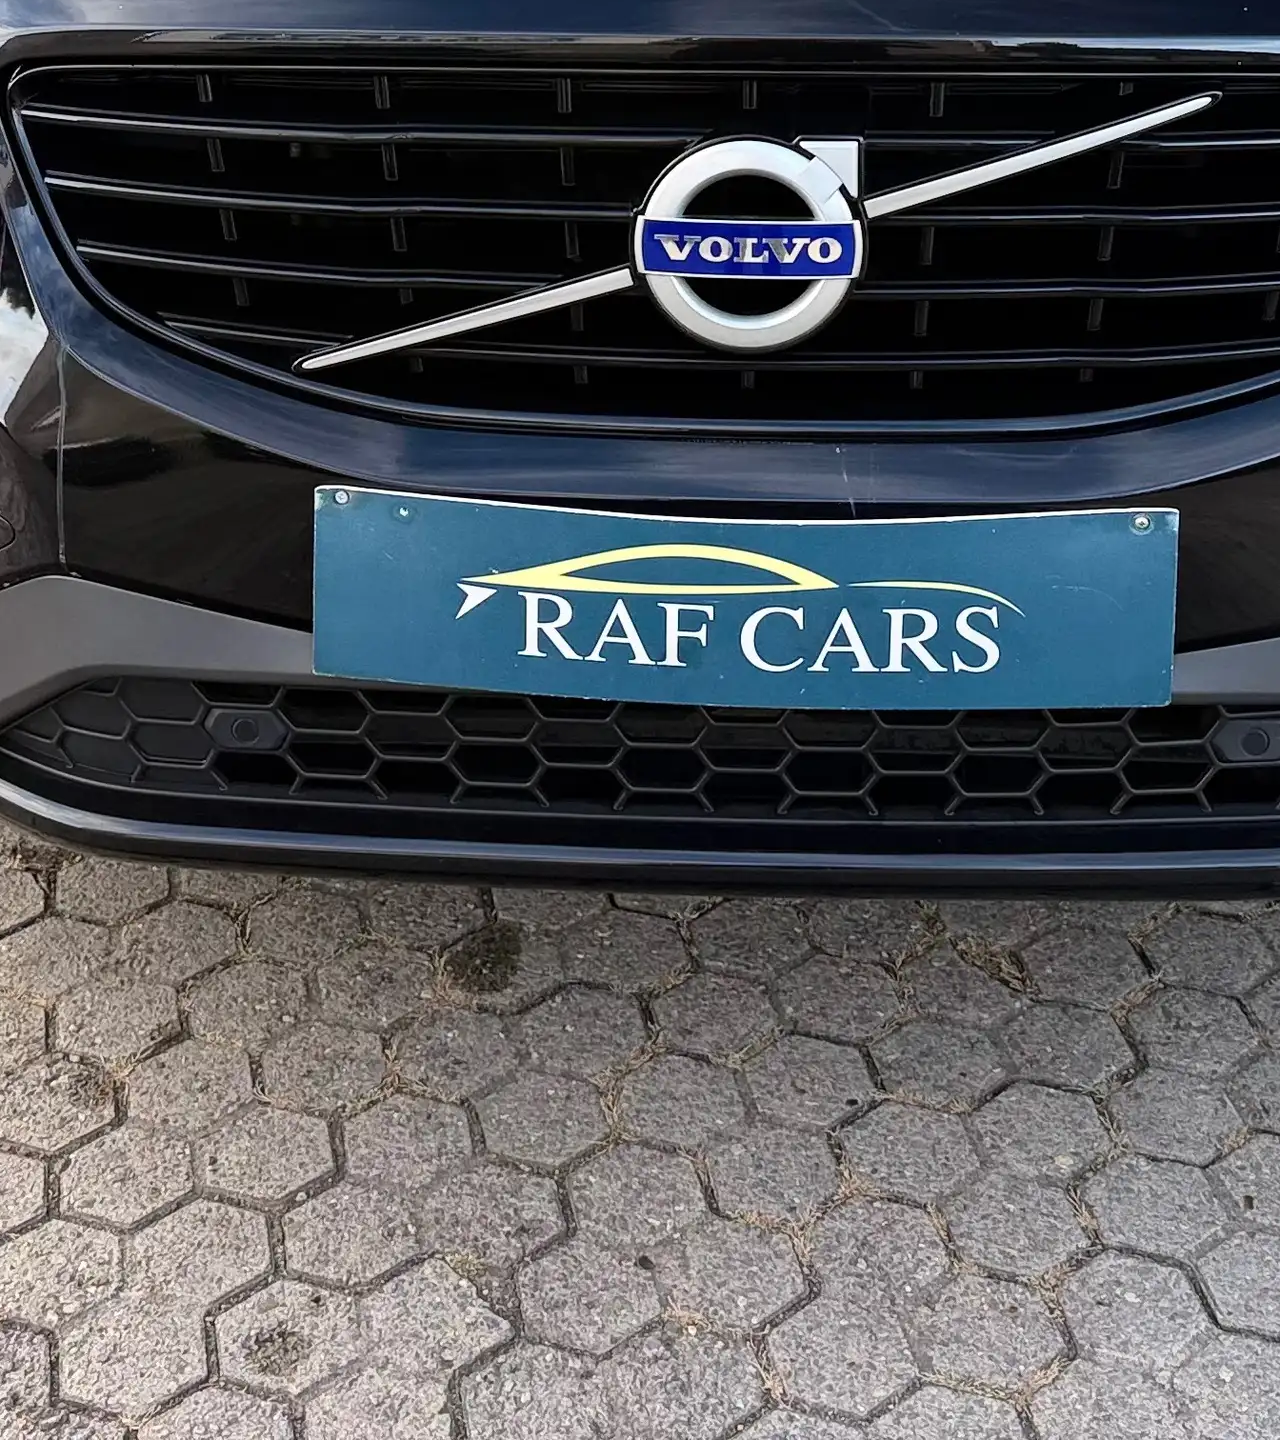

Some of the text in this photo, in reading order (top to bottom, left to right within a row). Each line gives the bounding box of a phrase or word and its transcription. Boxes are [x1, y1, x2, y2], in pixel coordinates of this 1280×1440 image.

[654, 234, 842, 264] VOLVO
[517, 590, 1003, 675] RAF CARS
